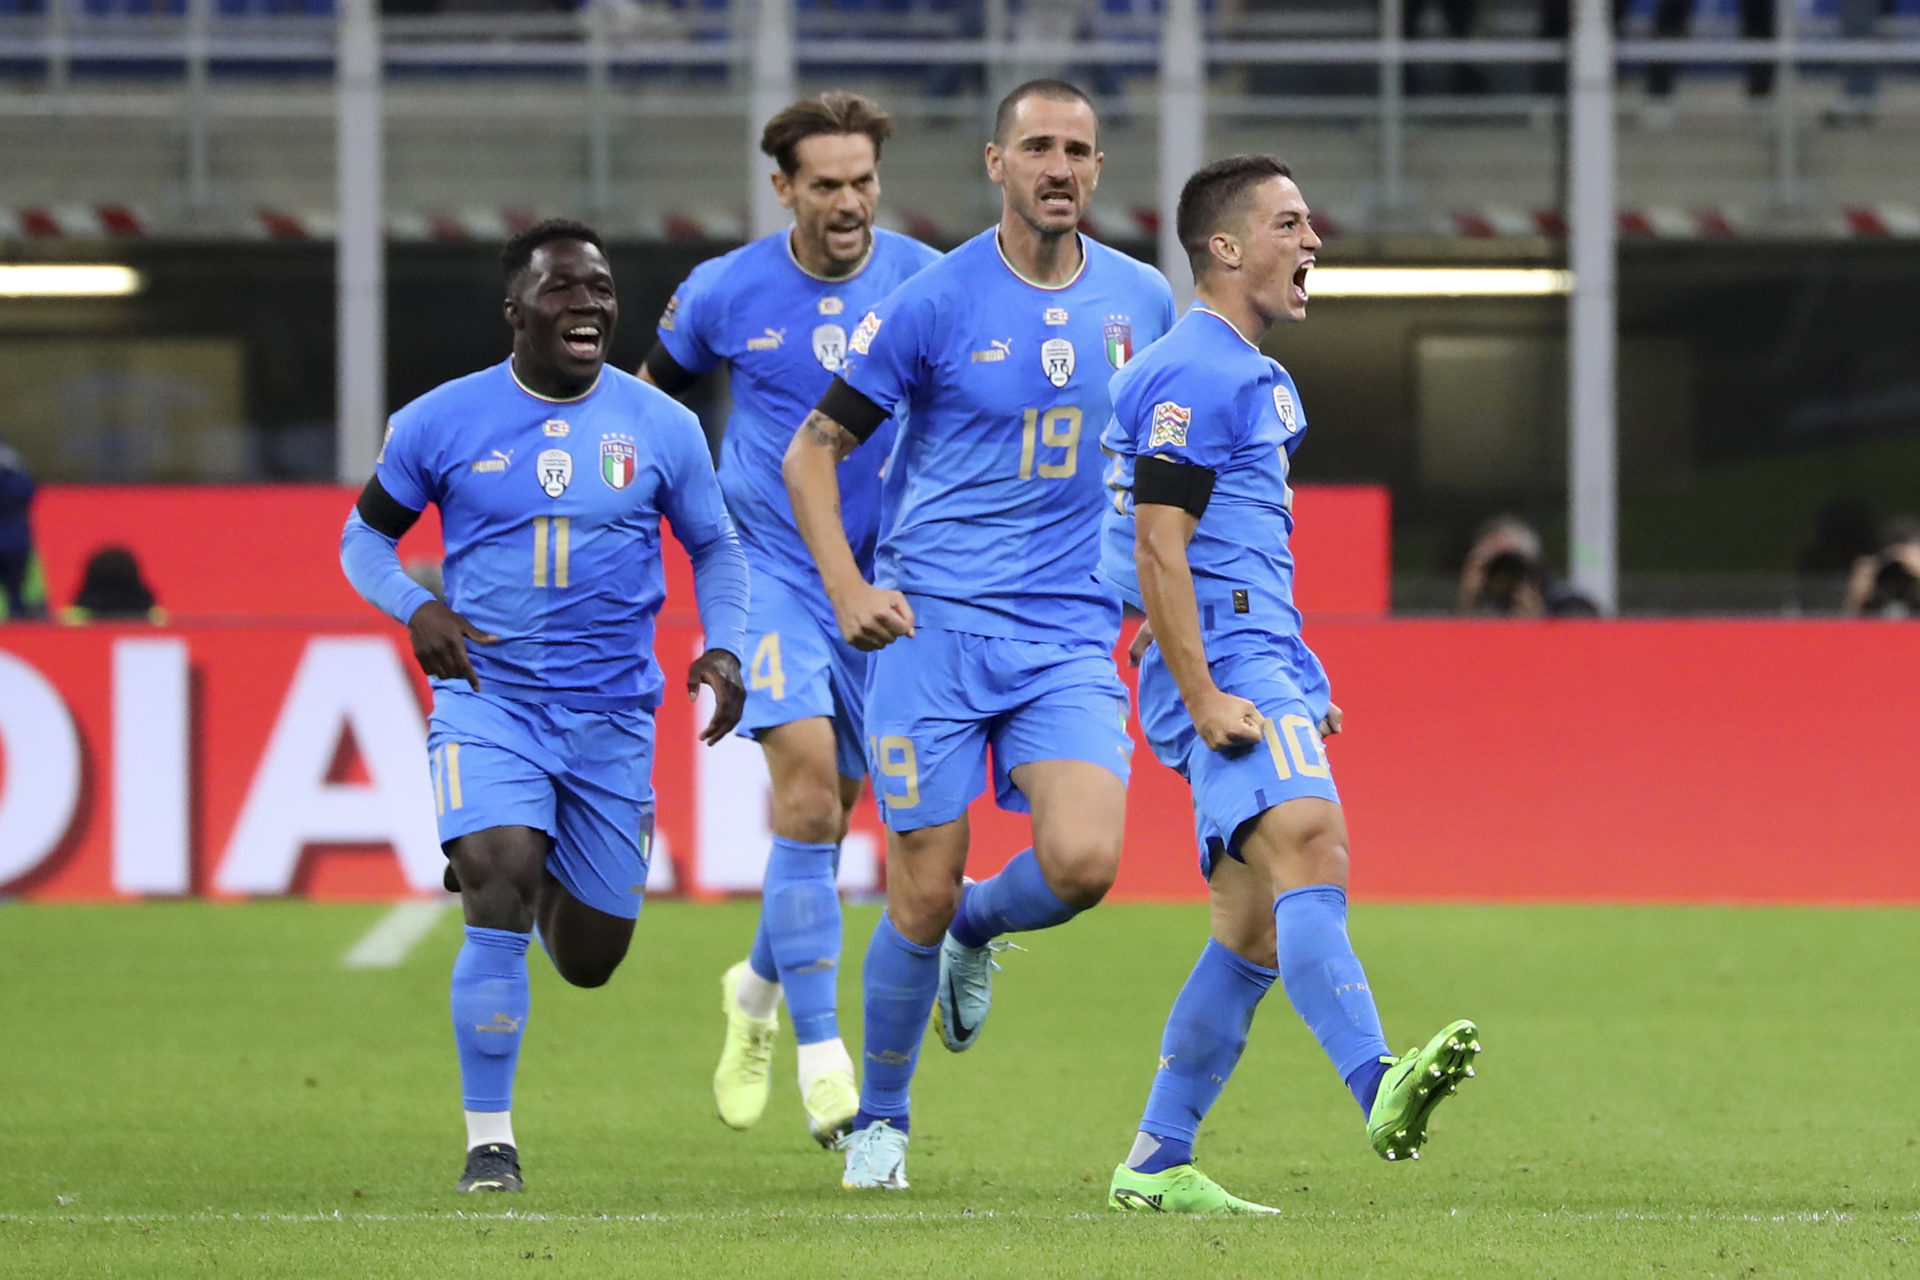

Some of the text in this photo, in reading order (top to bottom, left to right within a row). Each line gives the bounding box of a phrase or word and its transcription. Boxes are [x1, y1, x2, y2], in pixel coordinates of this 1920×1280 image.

[1018, 406, 1083, 480] 19
[533, 515, 571, 588] 11
[752, 632, 786, 701] 4
[434, 742, 463, 816] 11
[1263, 714, 1330, 780] 10
